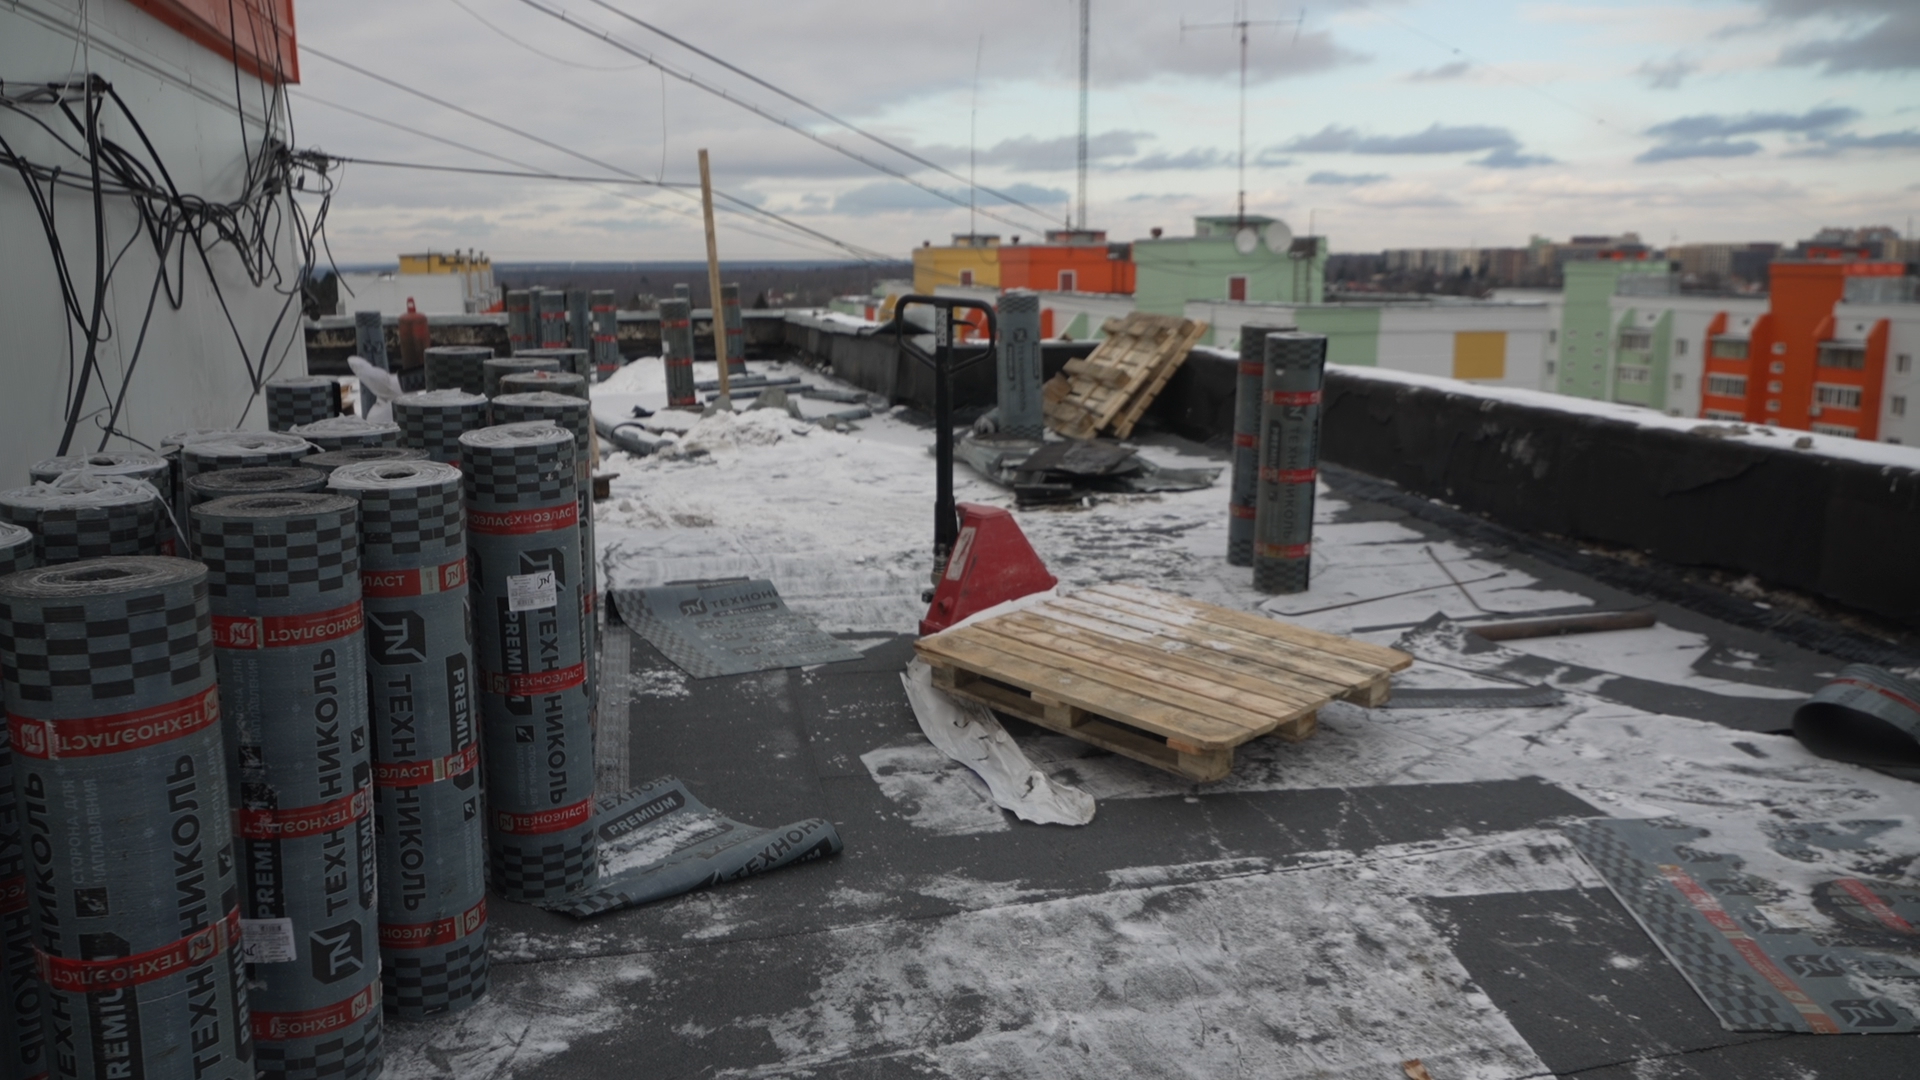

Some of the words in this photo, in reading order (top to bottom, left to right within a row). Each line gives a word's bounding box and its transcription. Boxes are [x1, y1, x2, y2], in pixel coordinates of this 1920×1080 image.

[268, 614, 361, 642] ТЕХНОЭЛАСТ
[514, 667, 583, 687] ТЕХНОЭЛАСТ
[60, 710, 203, 750] ТЕХНОЭЛАСТ
[538, 606, 568, 805] ТЕХННИКОЛЬ
[62, 779, 79, 811] ДЛЯ
[313, 649, 349, 917] ТЕХННИКОЛЬ
[387, 673, 428, 912] ТЕХННИКОЛЬ
[607, 796, 677, 835] PREMIUM
[0, 776, 43, 1066] ТЕХННИКОЛЬ
[166, 754, 221, 1080] ТЕХННИКОЛЬ
